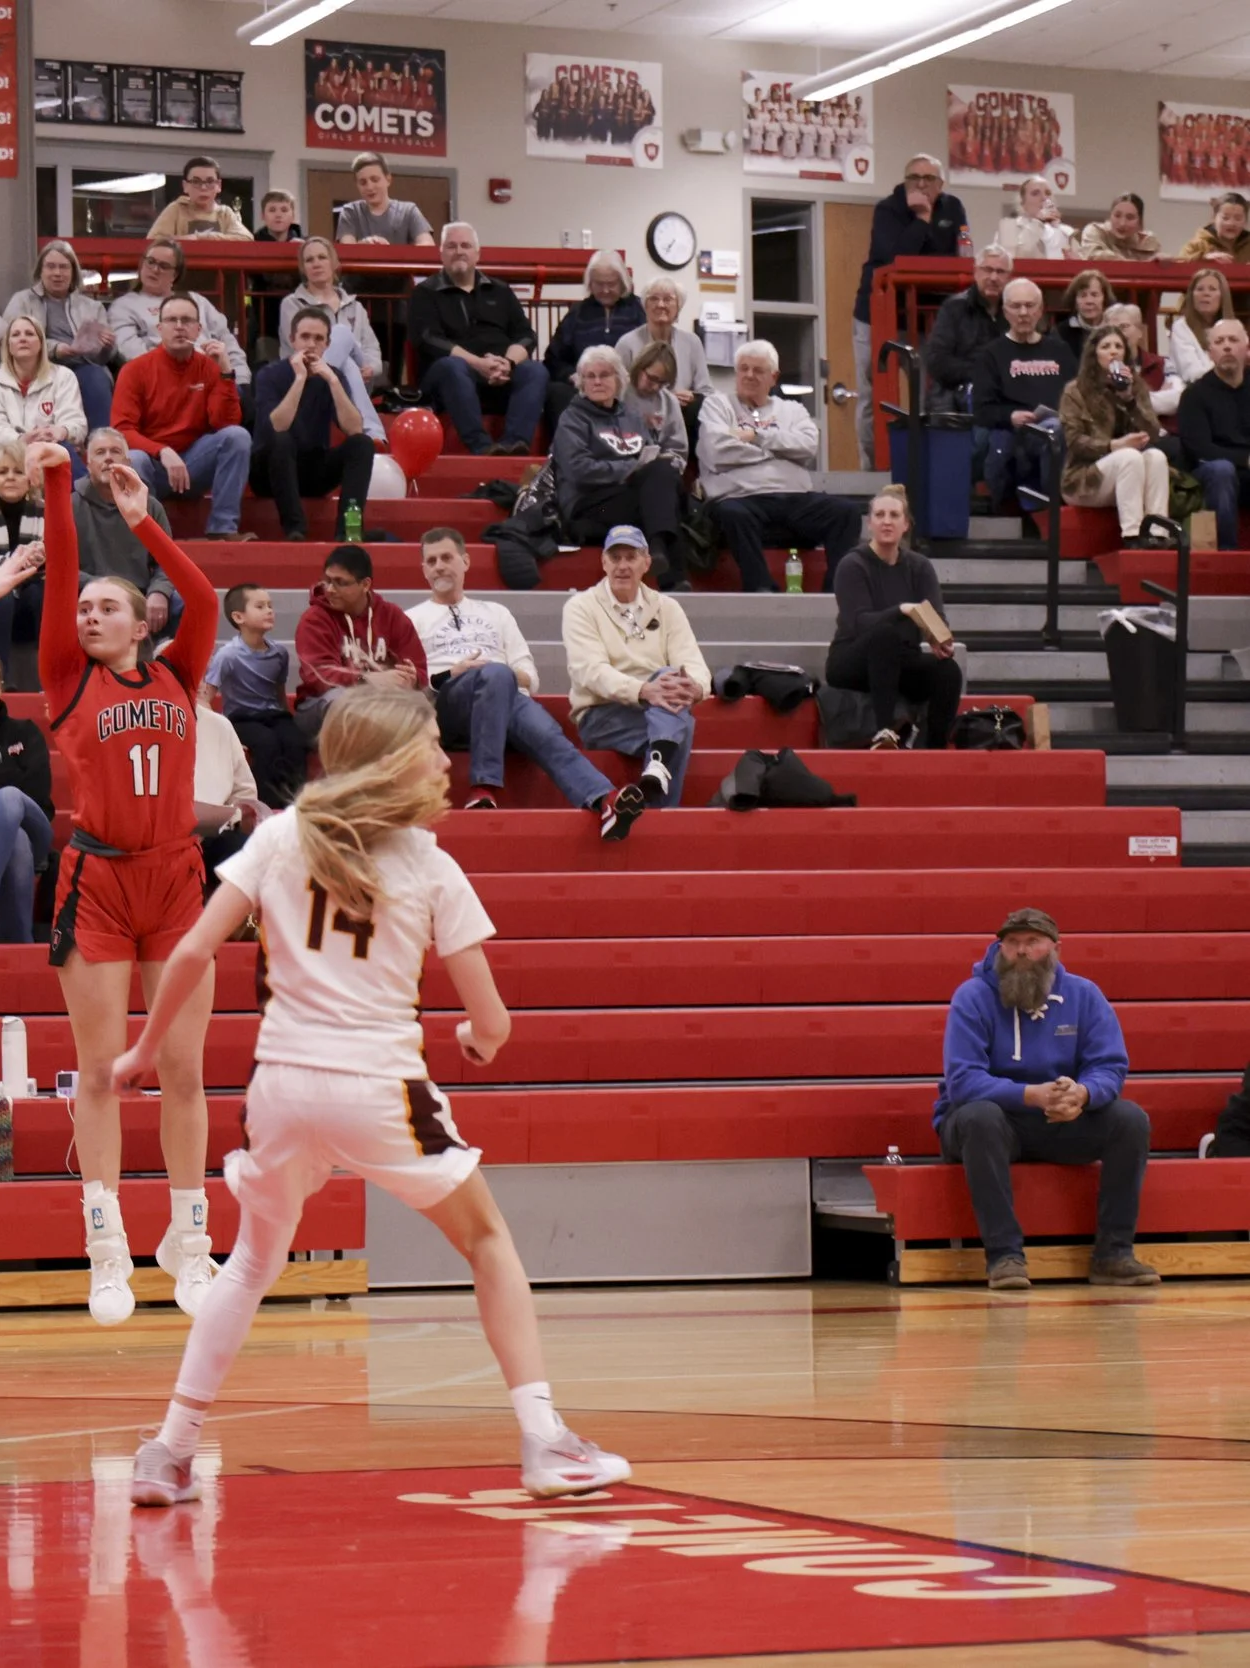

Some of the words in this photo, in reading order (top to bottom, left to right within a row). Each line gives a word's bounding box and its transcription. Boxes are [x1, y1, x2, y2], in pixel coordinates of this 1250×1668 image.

[314, 103, 435, 137] COMETS
[318, 132, 353, 142] GIRLS
[360, 134, 437, 148] BASKETBALL
[97, 698, 186, 742] COMETS
[128, 743, 160, 797] 11
[306, 876, 374, 960] 14
[397, 1486, 1117, 1600] COMETS
